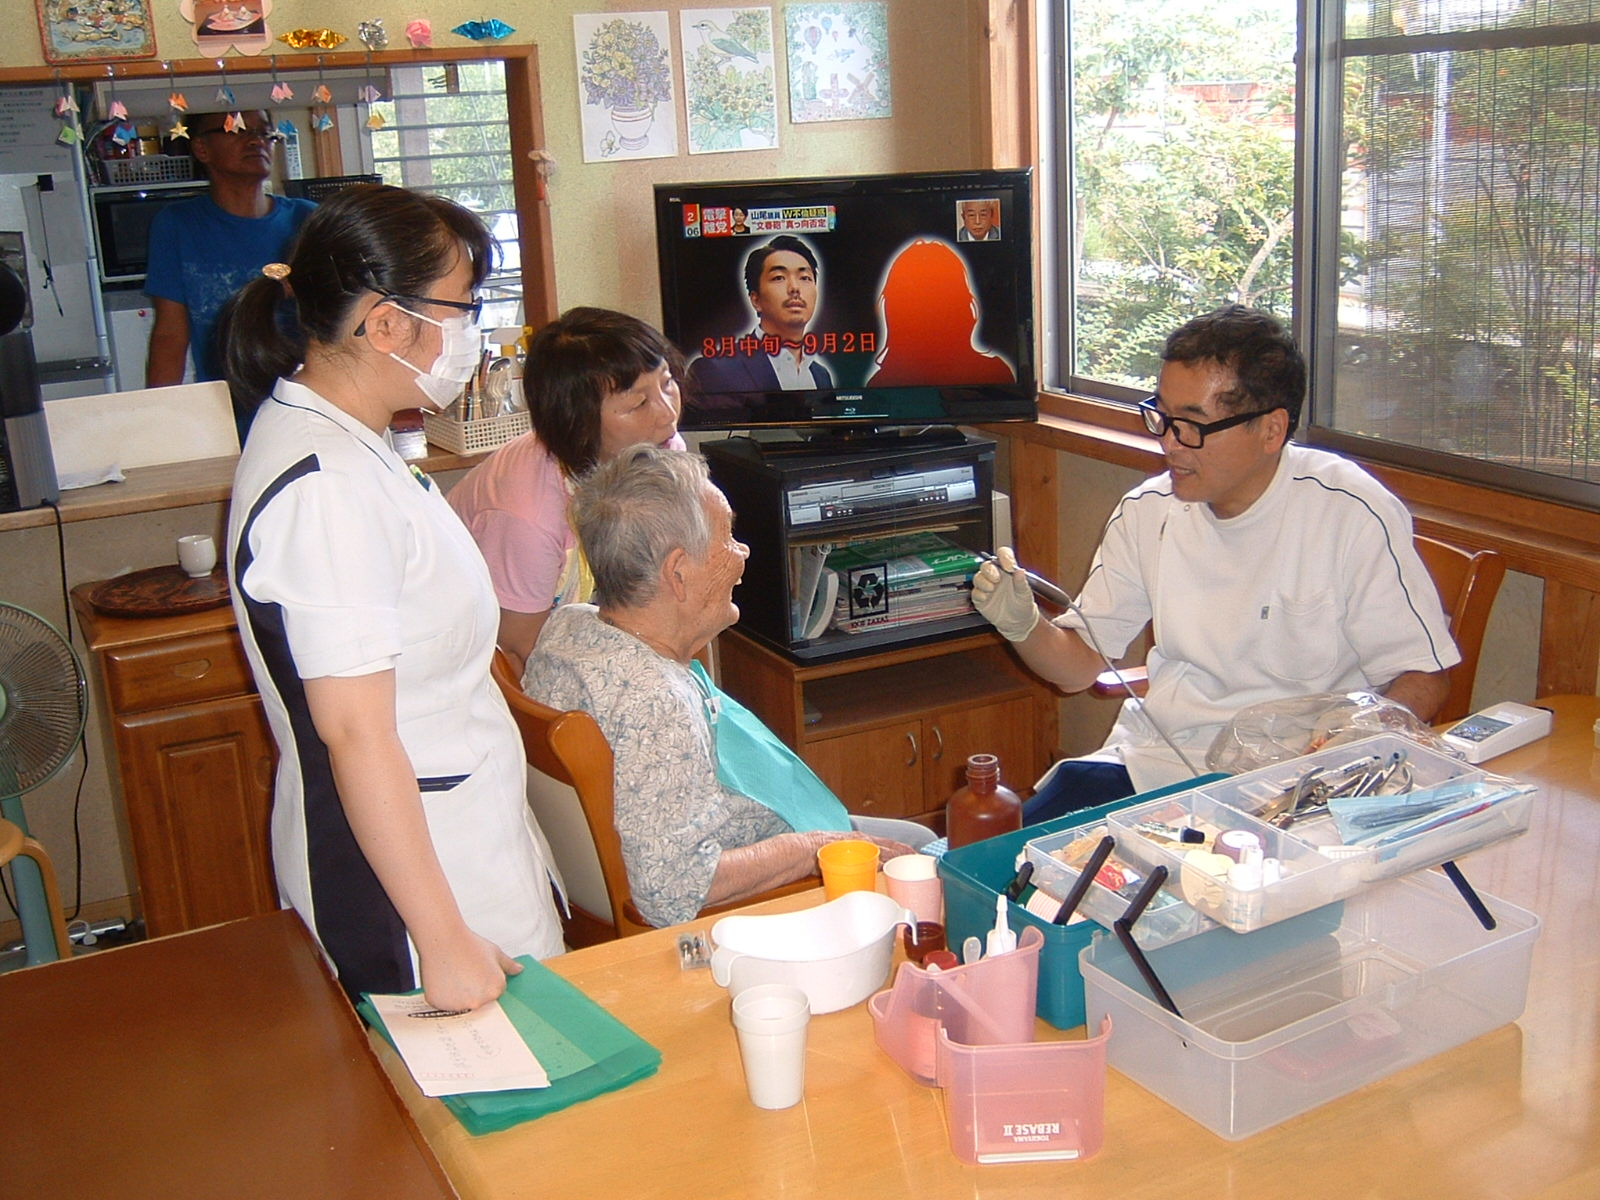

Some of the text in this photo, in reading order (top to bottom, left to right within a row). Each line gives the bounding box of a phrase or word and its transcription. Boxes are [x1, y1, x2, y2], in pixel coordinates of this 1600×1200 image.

[687, 212, 695, 222] 2
[687, 227, 700, 236] 06
[1015, 1123, 1059, 1135] REBASE
